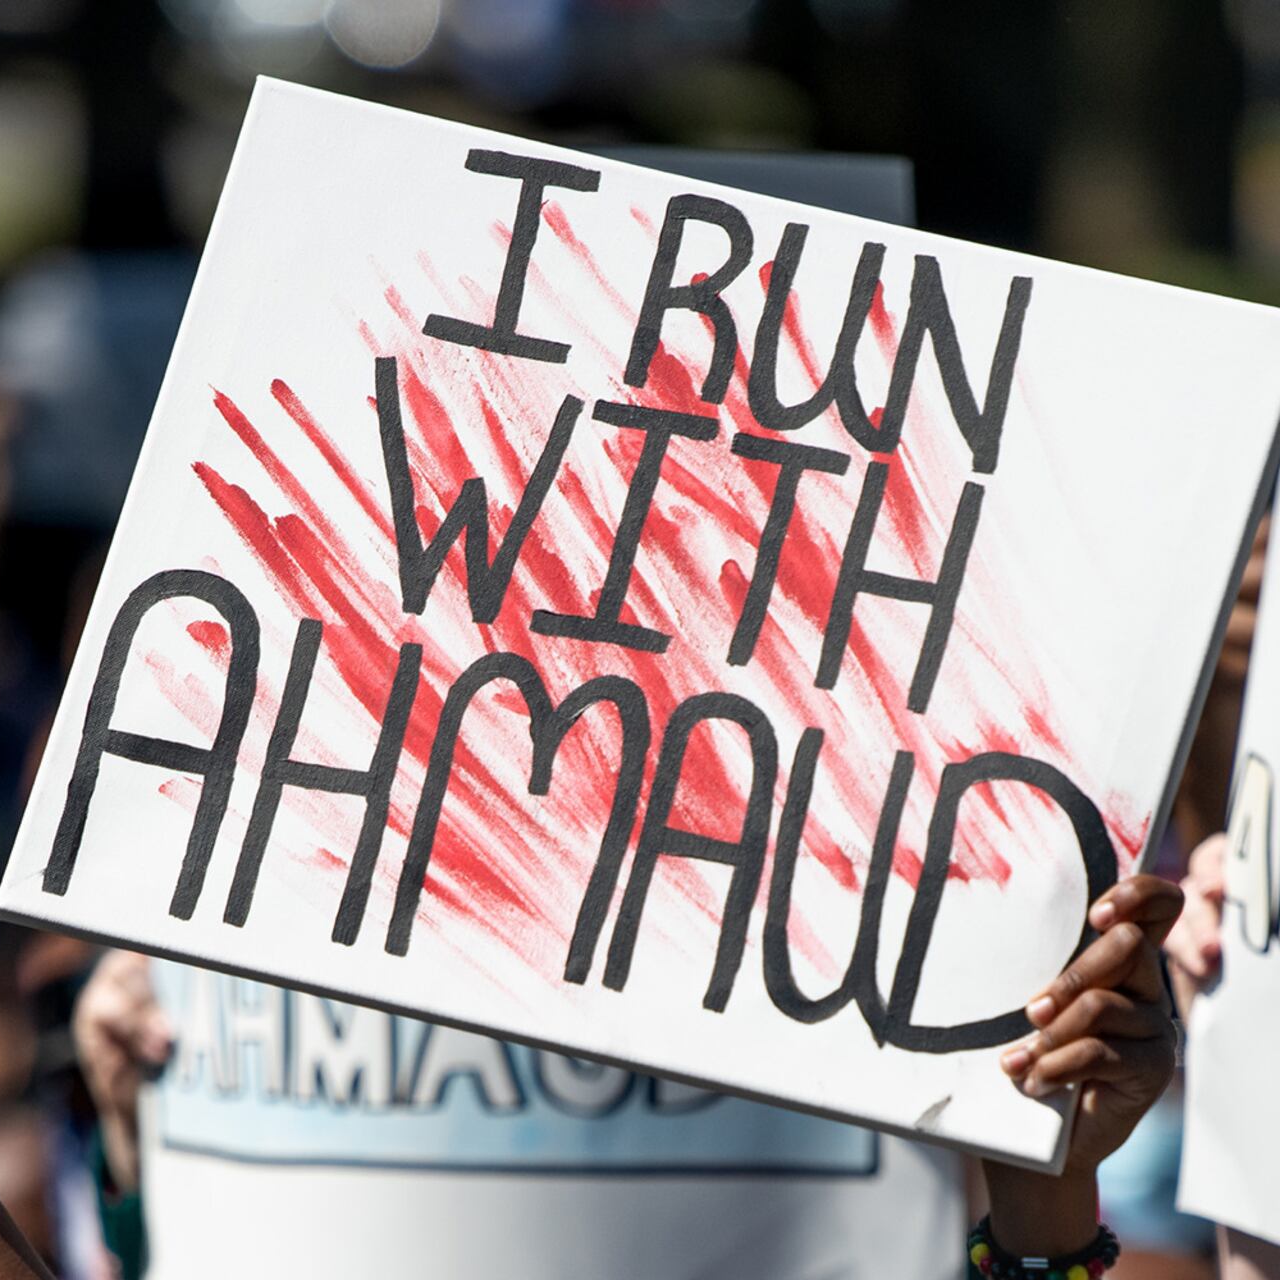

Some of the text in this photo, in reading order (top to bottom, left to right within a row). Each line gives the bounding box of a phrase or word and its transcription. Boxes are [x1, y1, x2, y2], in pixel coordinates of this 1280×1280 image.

[422, 147, 1033, 474] I RUN
[375, 355, 985, 715] WITH
[41, 569, 1119, 1055] AHMAUD
